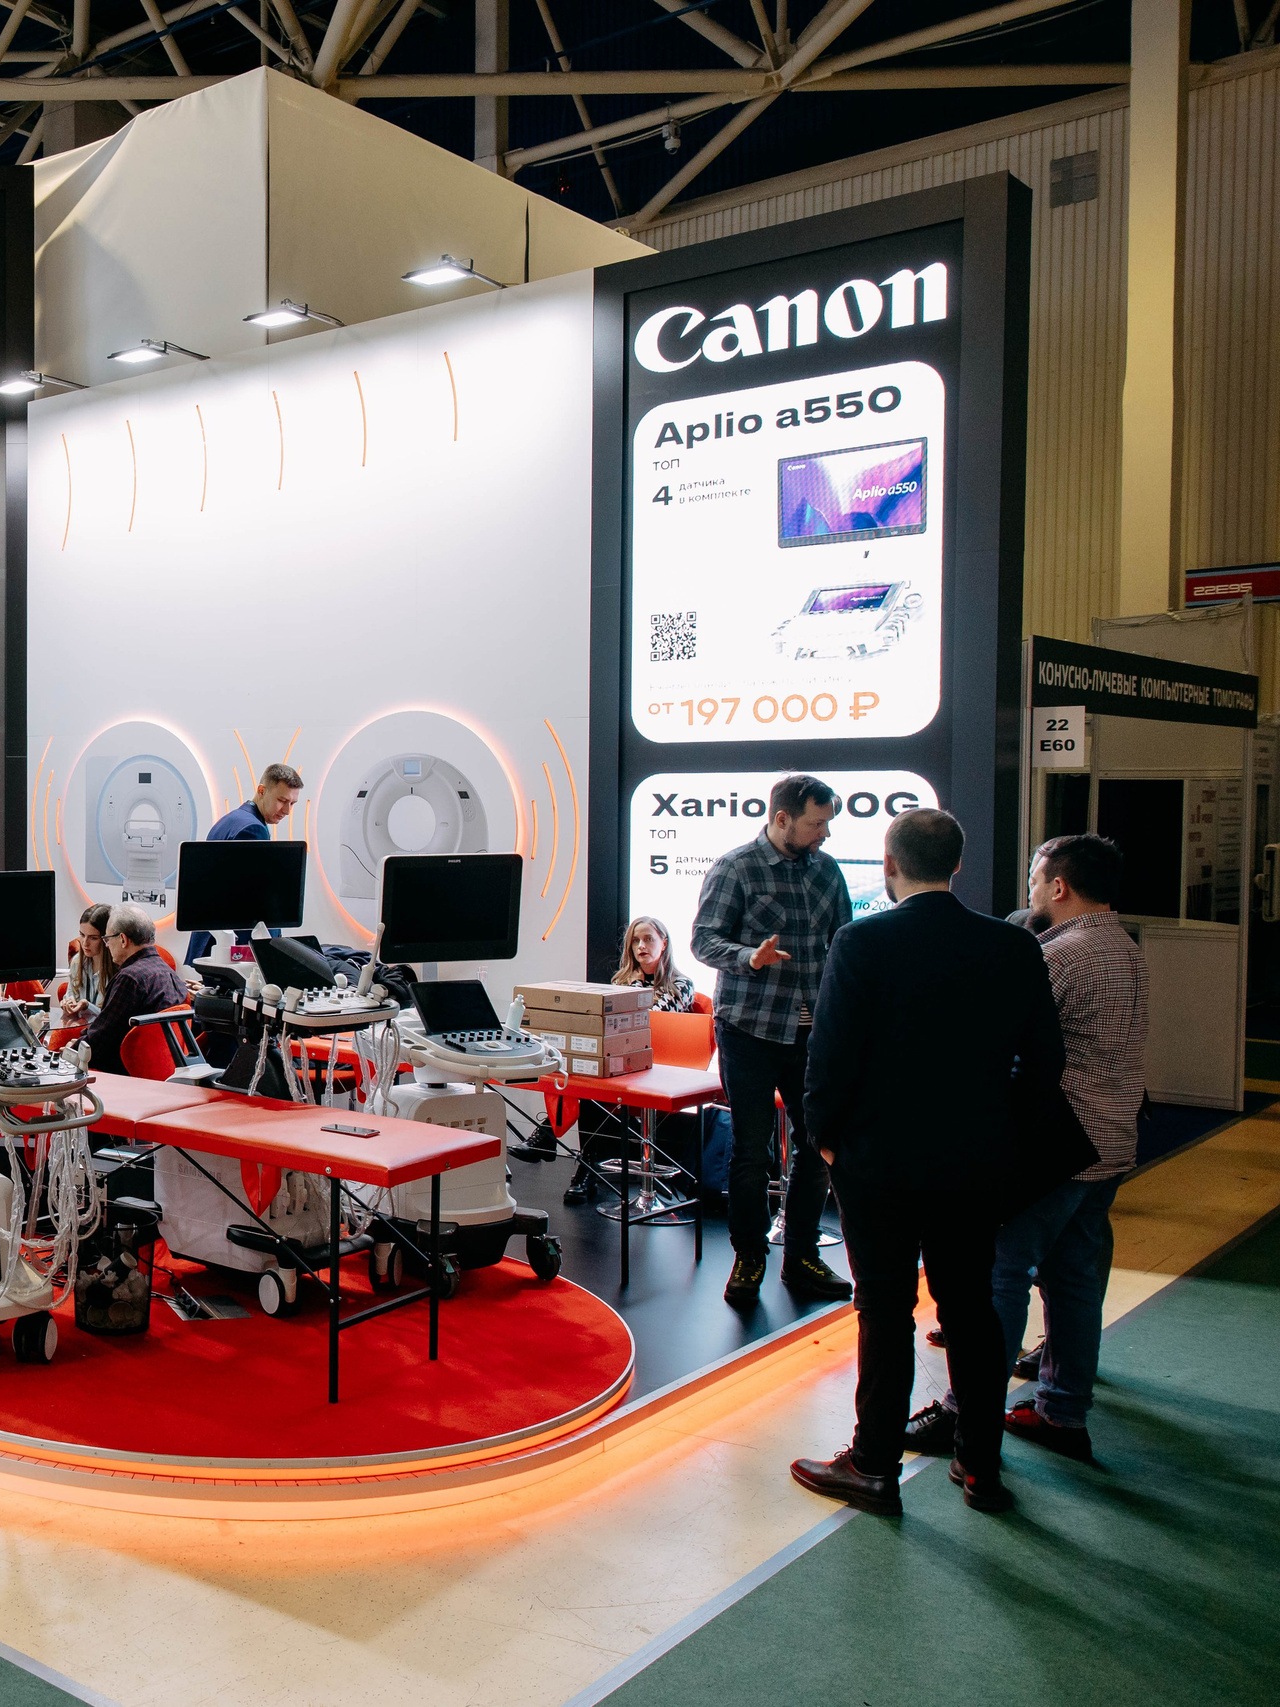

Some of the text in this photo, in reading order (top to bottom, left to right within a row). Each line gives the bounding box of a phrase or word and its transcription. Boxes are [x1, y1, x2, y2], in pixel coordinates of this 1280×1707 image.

[634, 262, 947, 373] Canon
[654, 385, 902, 449] Aplio a550
[653, 459, 680, 471] ТОП
[652, 478, 725, 506] 4 датчика
[852, 481, 917, 501] Aplio a550
[1039, 660, 1137, 698] КОНУСНО-ЛУЧЕВЫЕ
[1141, 677, 1210, 707] КОМПЬЮТЕРНЫЕ
[681, 697, 741, 726] 197
[753, 692, 838, 723] 000
[849, 691, 880, 721] ₽
[1045, 718, 1069, 732] 22
[1039, 739, 1075, 752] E60
[651, 792, 766, 817] Xario
[650, 829, 676, 839] ТОП
[650, 855, 669, 875] 5
